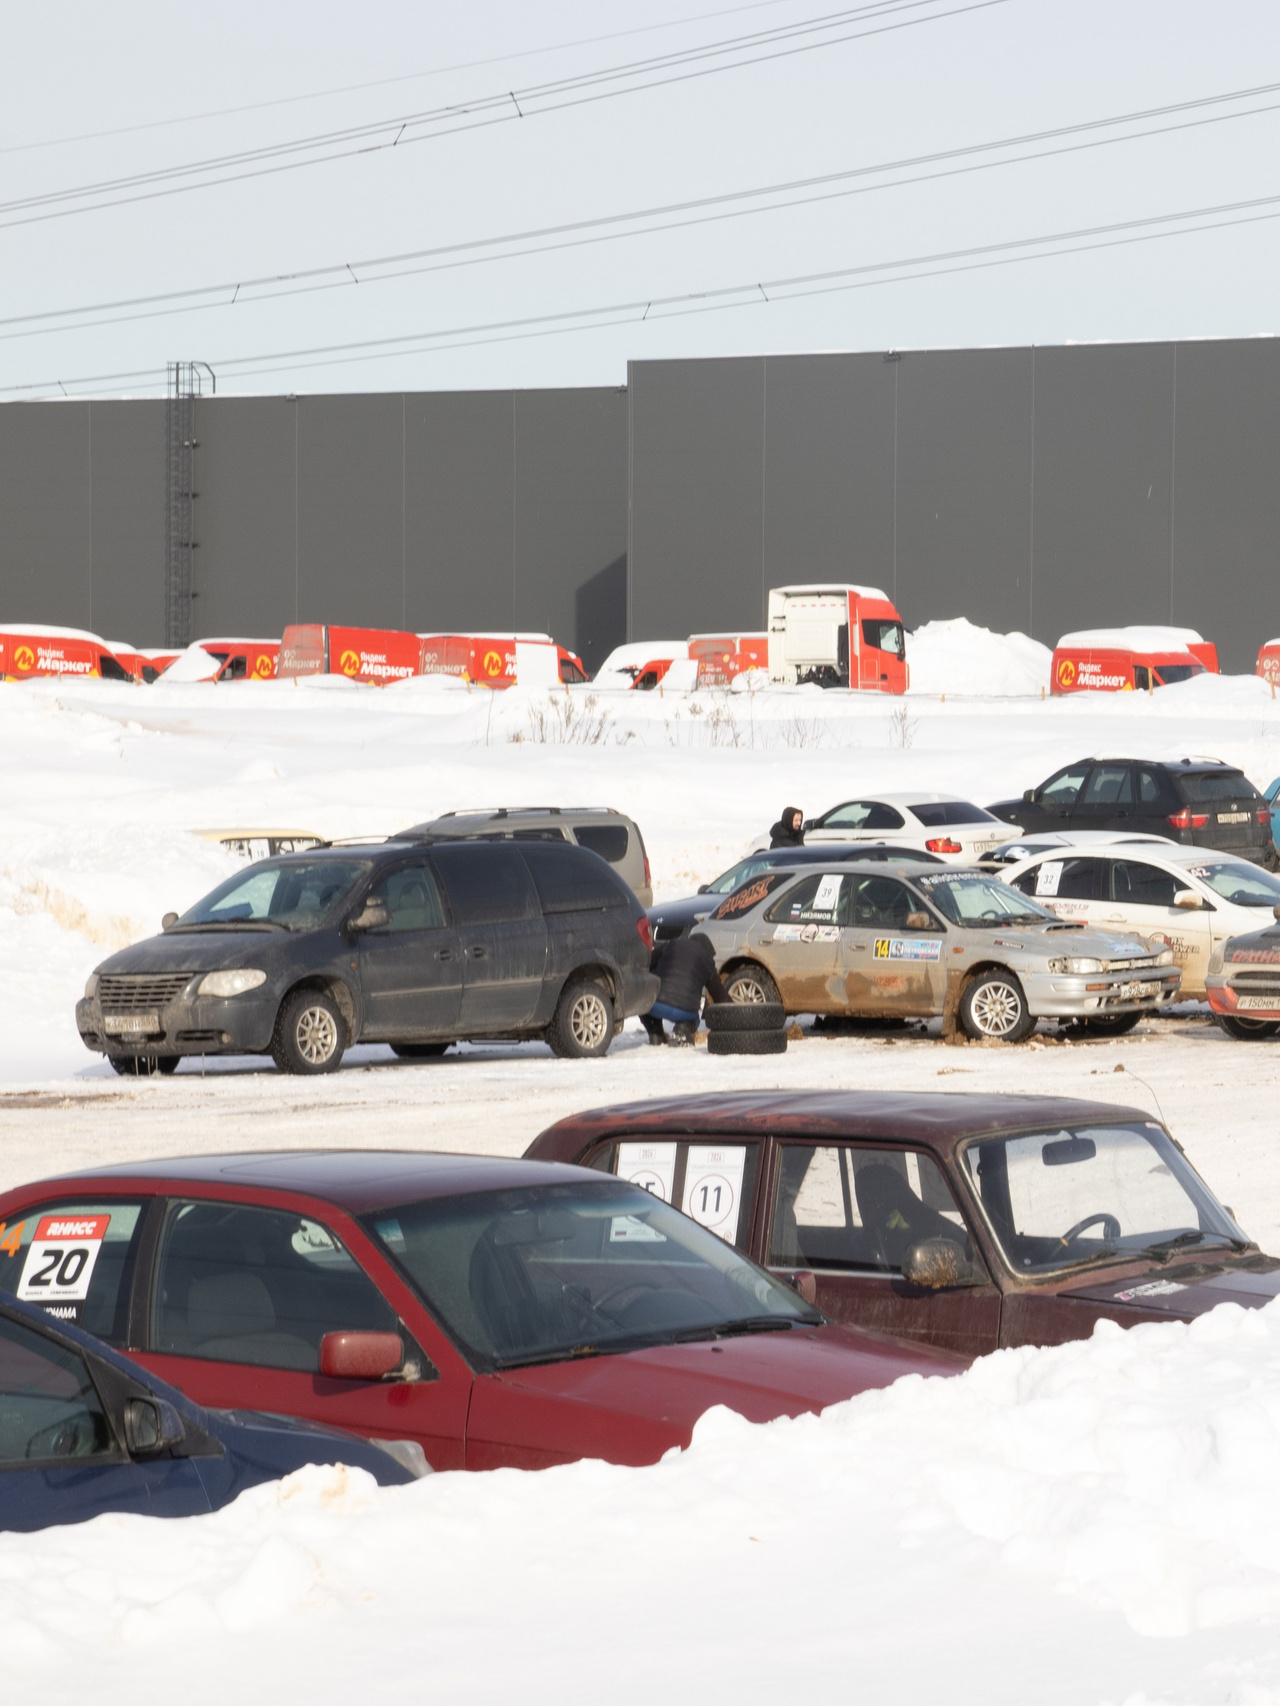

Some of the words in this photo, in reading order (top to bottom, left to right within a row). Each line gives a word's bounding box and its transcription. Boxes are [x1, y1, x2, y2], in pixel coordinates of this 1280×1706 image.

[37, 647, 64, 659] Яндекс
[360, 651, 387, 663] Яндекс
[37, 658, 91, 673] Маркет
[360, 662, 414, 678] Маркет
[424, 662, 466, 674] Маркет
[1078, 661, 1101, 673] Яндекс
[1077, 671, 1126, 687] Маркет
[1044, 875, 1054, 885] 32
[822, 888, 832, 898] 39
[876, 940, 889, 958] 14
[700, 1186, 722, 1212] 11
[28, 1248, 89, 1286] 20
